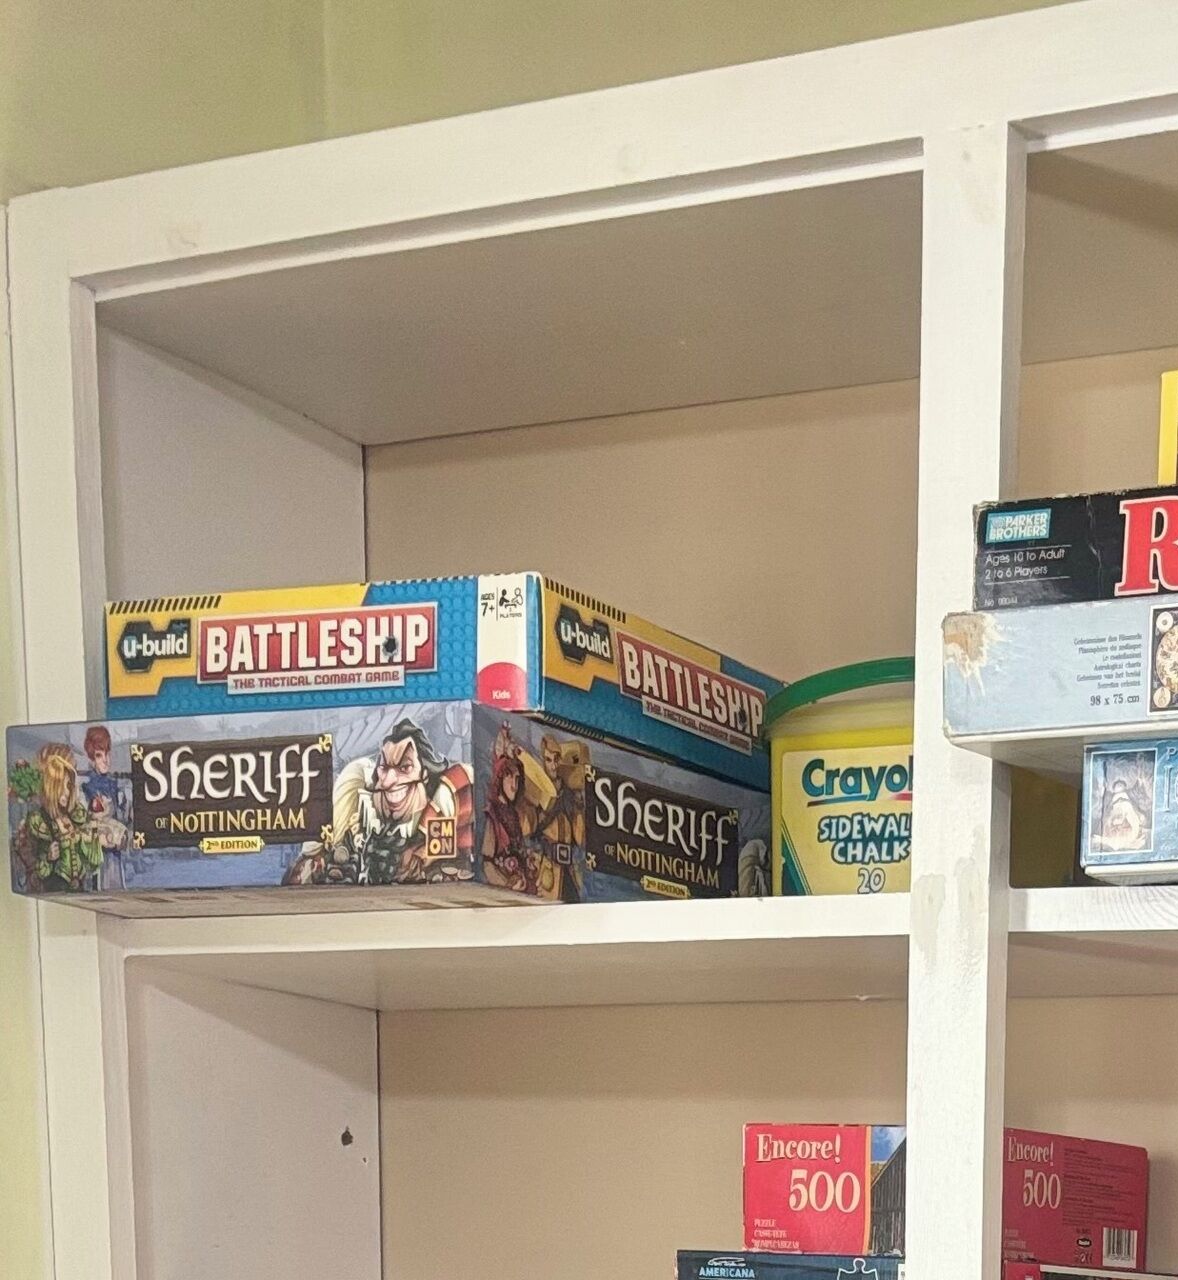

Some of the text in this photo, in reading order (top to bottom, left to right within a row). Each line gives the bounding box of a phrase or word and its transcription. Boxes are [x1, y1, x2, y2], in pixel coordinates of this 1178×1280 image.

[989, 525, 1047, 540] BROTHERS
[1005, 513, 1047, 527] PARKER
[985, 549, 1066, 567] Ages 10 to Adult
[985, 565, 1049, 580] 2 6 Players
[480, 601, 495, 617] 7+
[122, 613, 430, 674] u-build BATTLESHIP
[232, 670, 400, 690] THE TACTICAL COMBAT GAME
[560, 620, 611, 658] u-build
[621, 640, 764, 738] BATTLESHIP
[1090, 693, 1123, 707] 98 75
[801, 757, 913, 803] Crayol
[170, 808, 306, 834] NOTTINGHAM
[818, 812, 912, 842] SIDEWAL
[220, 838, 258, 851] EDITION
[832, 839, 911, 866] CHALK
[616, 841, 720, 890] NOTTINGHAM
[857, 868, 886, 894] 20
[755, 1133, 841, 1163] Encore!
[1007, 1136, 1055, 1167] Encore!
[788, 1168, 861, 1213] 500
[1022, 1168, 1062, 1209] 500
[698, 1267, 756, 1279] AMERICANA
